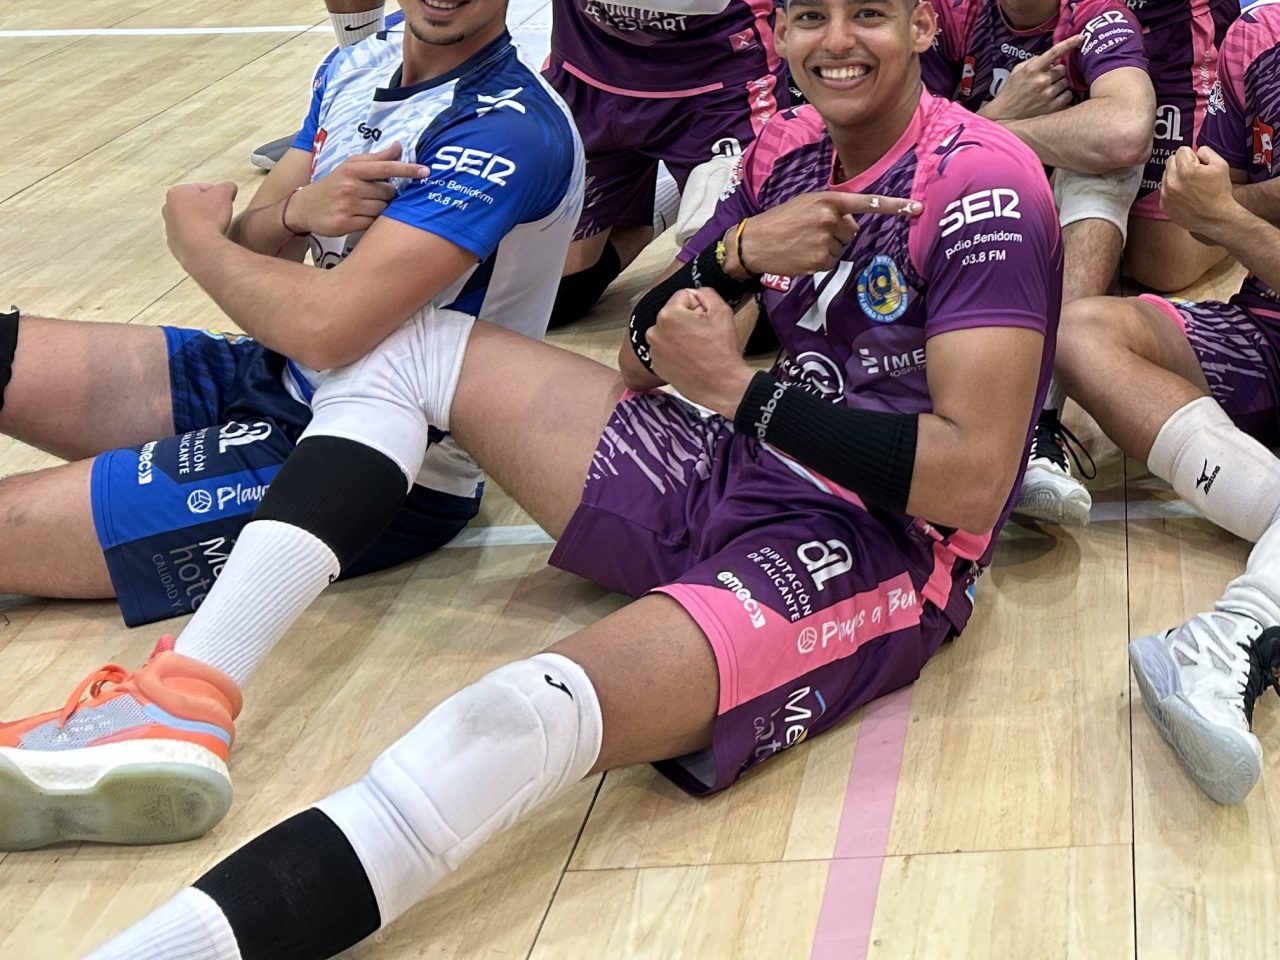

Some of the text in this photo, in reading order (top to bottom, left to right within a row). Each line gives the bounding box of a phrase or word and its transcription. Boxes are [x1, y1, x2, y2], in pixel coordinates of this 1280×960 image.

[1081, 10, 1128, 53] SER
[1094, 39, 1115, 55] 103.8
[432, 145, 517, 187] SER
[446, 180, 495, 205] Benidorm
[939, 188, 1022, 238] SER
[961, 249, 1007, 266] 03.8 FM
[972, 230, 1023, 246] Benidorm
[884, 349, 926, 372] IME
[152, 553, 178, 599] CALIDAD
[747, 552, 800, 622] DE ALICANTE
[759, 546, 812, 616] DIPUTACIÓN
